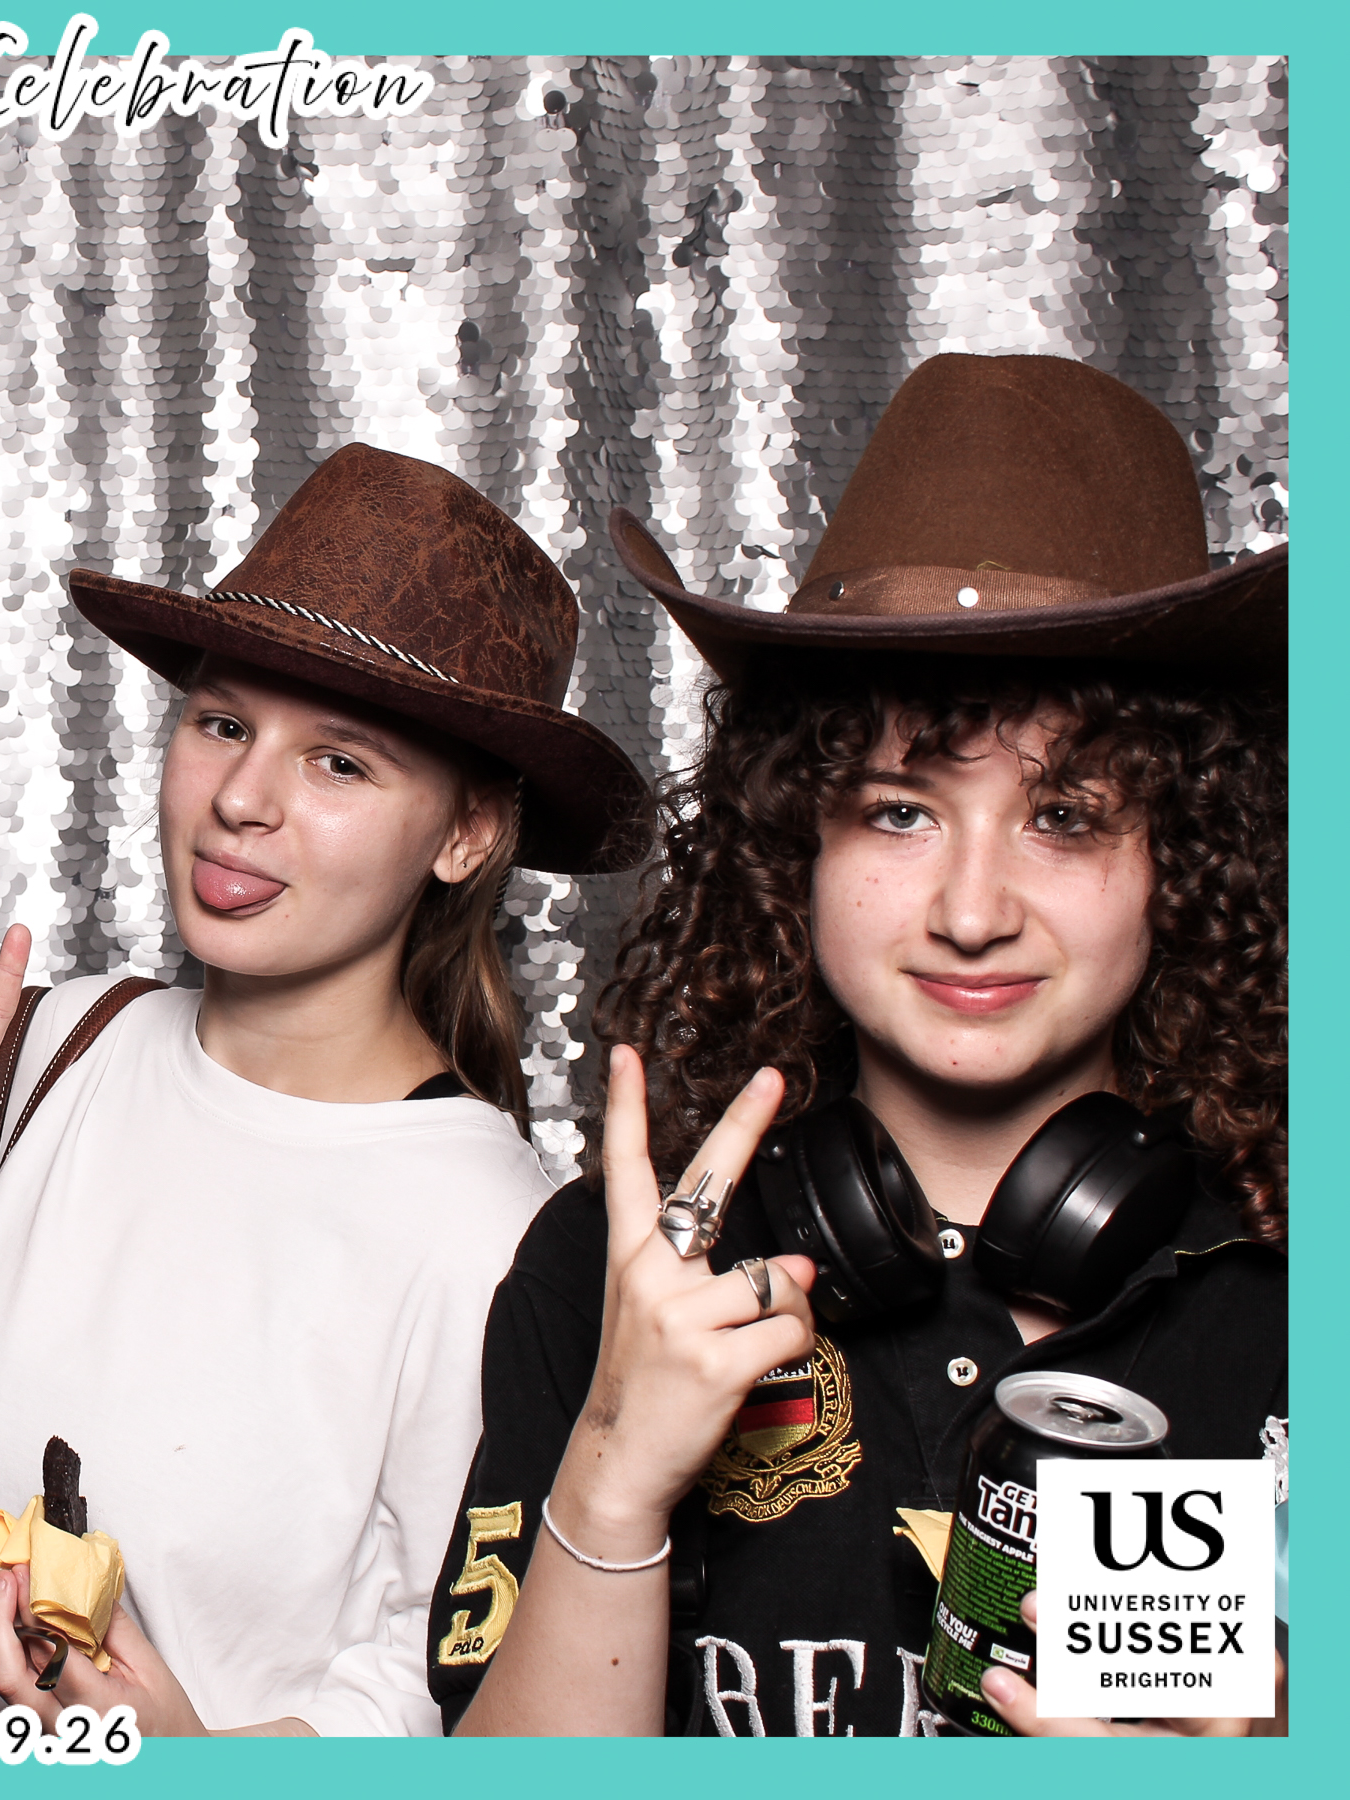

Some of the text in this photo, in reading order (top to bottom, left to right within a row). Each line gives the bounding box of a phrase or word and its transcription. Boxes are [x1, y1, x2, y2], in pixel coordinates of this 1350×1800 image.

[979, 1475, 1037, 1542] Tan
[967, 1520, 1003, 1549] TANGIEST
[1002, 1543, 1035, 1563] APPLE
[438, 1501, 522, 1665] 5
[950, 1613, 978, 1643] YOU!
[958, 1635, 974, 1651] ME
